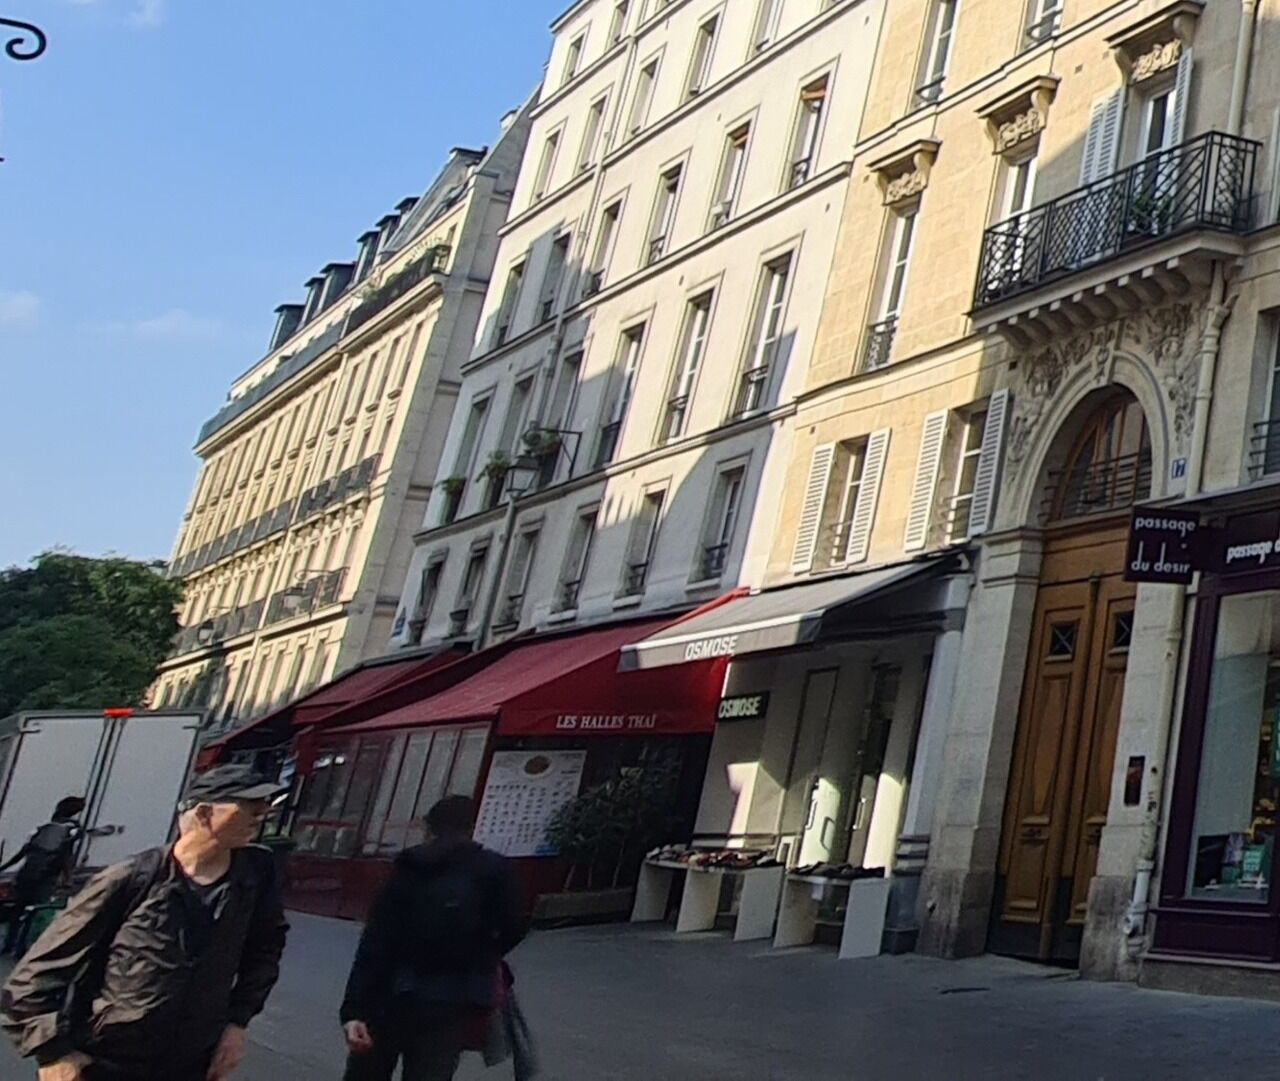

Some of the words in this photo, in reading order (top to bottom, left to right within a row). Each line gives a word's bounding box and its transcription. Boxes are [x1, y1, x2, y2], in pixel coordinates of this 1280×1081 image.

[1134, 516, 1196, 538] passage
[1130, 540, 1150, 573] du
[1225, 539, 1273, 565] passage
[684, 635, 739, 661] OSMOSE
[718, 695, 762, 719] OSMOSE
[556, 715, 577, 729] LES
[580, 715, 625, 729] HALLES
[627, 713, 657, 729] THAÏ
